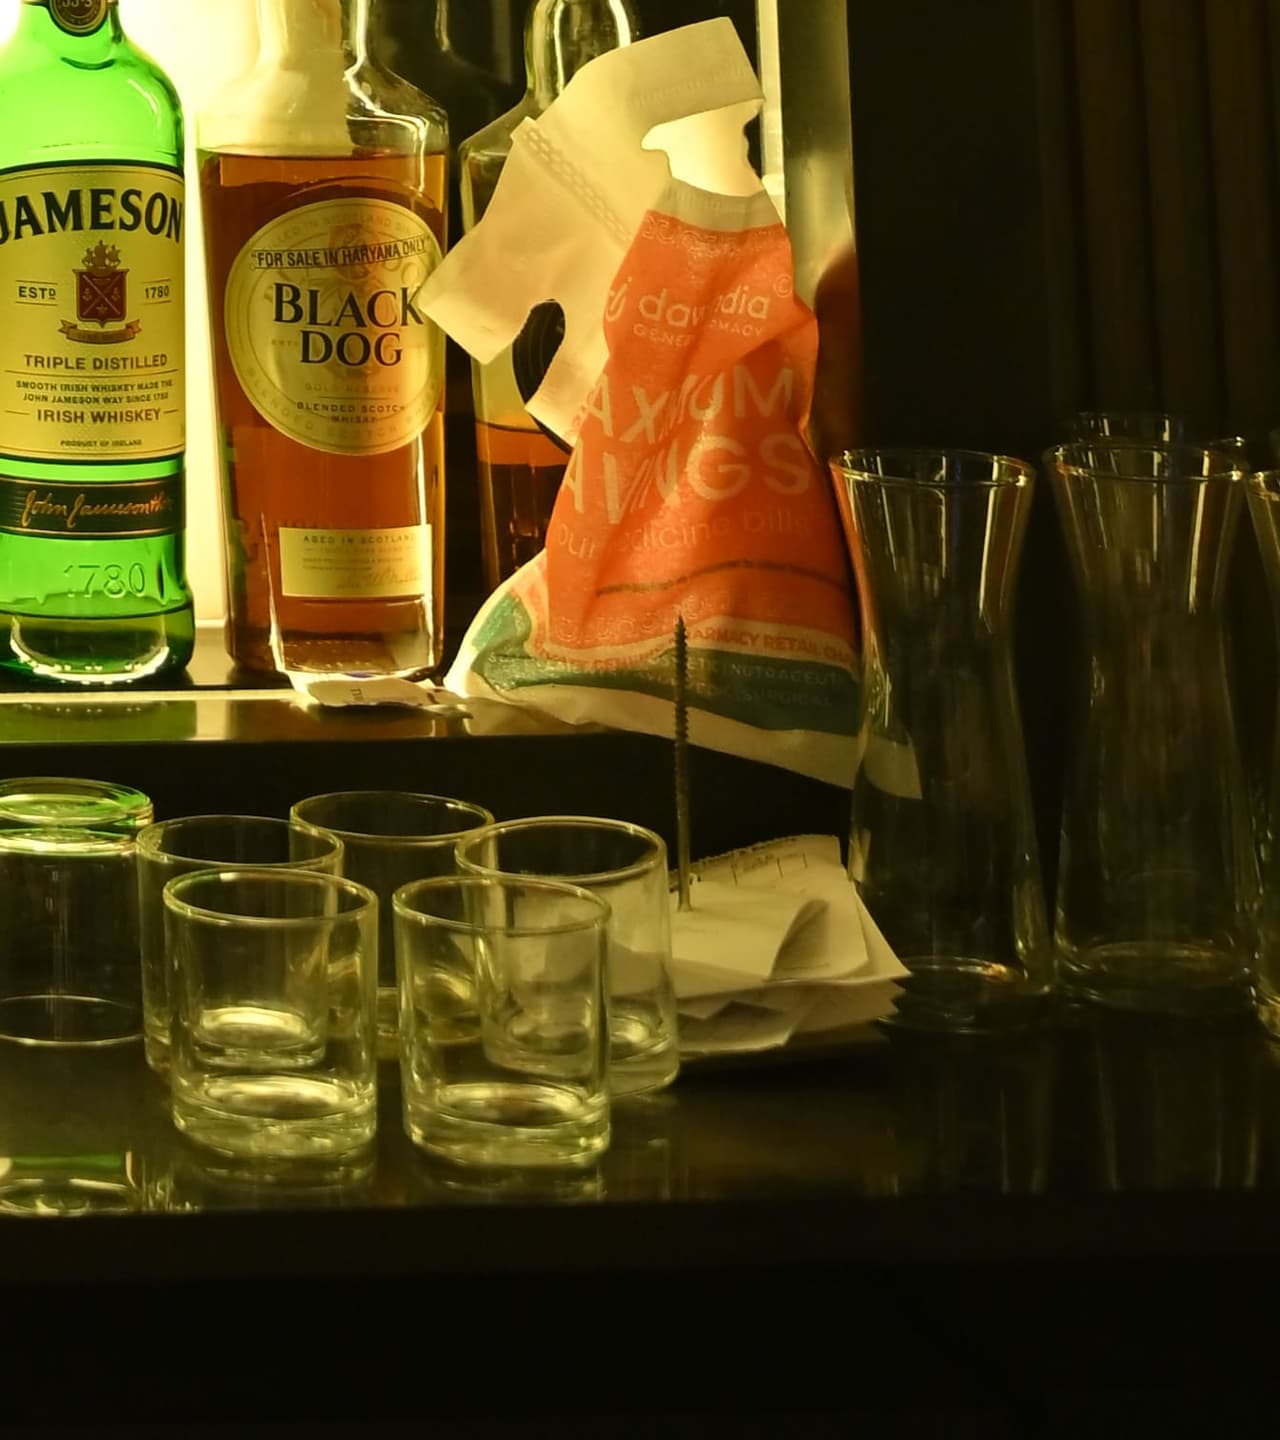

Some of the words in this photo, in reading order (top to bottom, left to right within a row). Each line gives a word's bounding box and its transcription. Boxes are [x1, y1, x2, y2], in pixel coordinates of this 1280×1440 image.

[287, 250, 321, 268] SALE
[323, 249, 339, 266] IN
[342, 243, 401, 265] HARYANA
[272, 281, 425, 329] BLACK
[299, 328, 403, 368] DOG
[23, 353, 87, 371] TRIPLE
[92, 352, 169, 371] DISTILLED
[15, 379, 58, 393] SMOOTH
[60, 382, 89, 393] IRISH
[90, 382, 136, 393] WHISKEY
[22, 392, 49, 403] JOHN
[51, 394, 101, 405] JAMESON
[102, 395, 124, 405] WAY
[125, 393, 152, 404] SINCE
[296, 401, 356, 414] BLENDED
[36, 408, 86, 425] IRISH
[90, 407, 162, 425] WHISKEY
